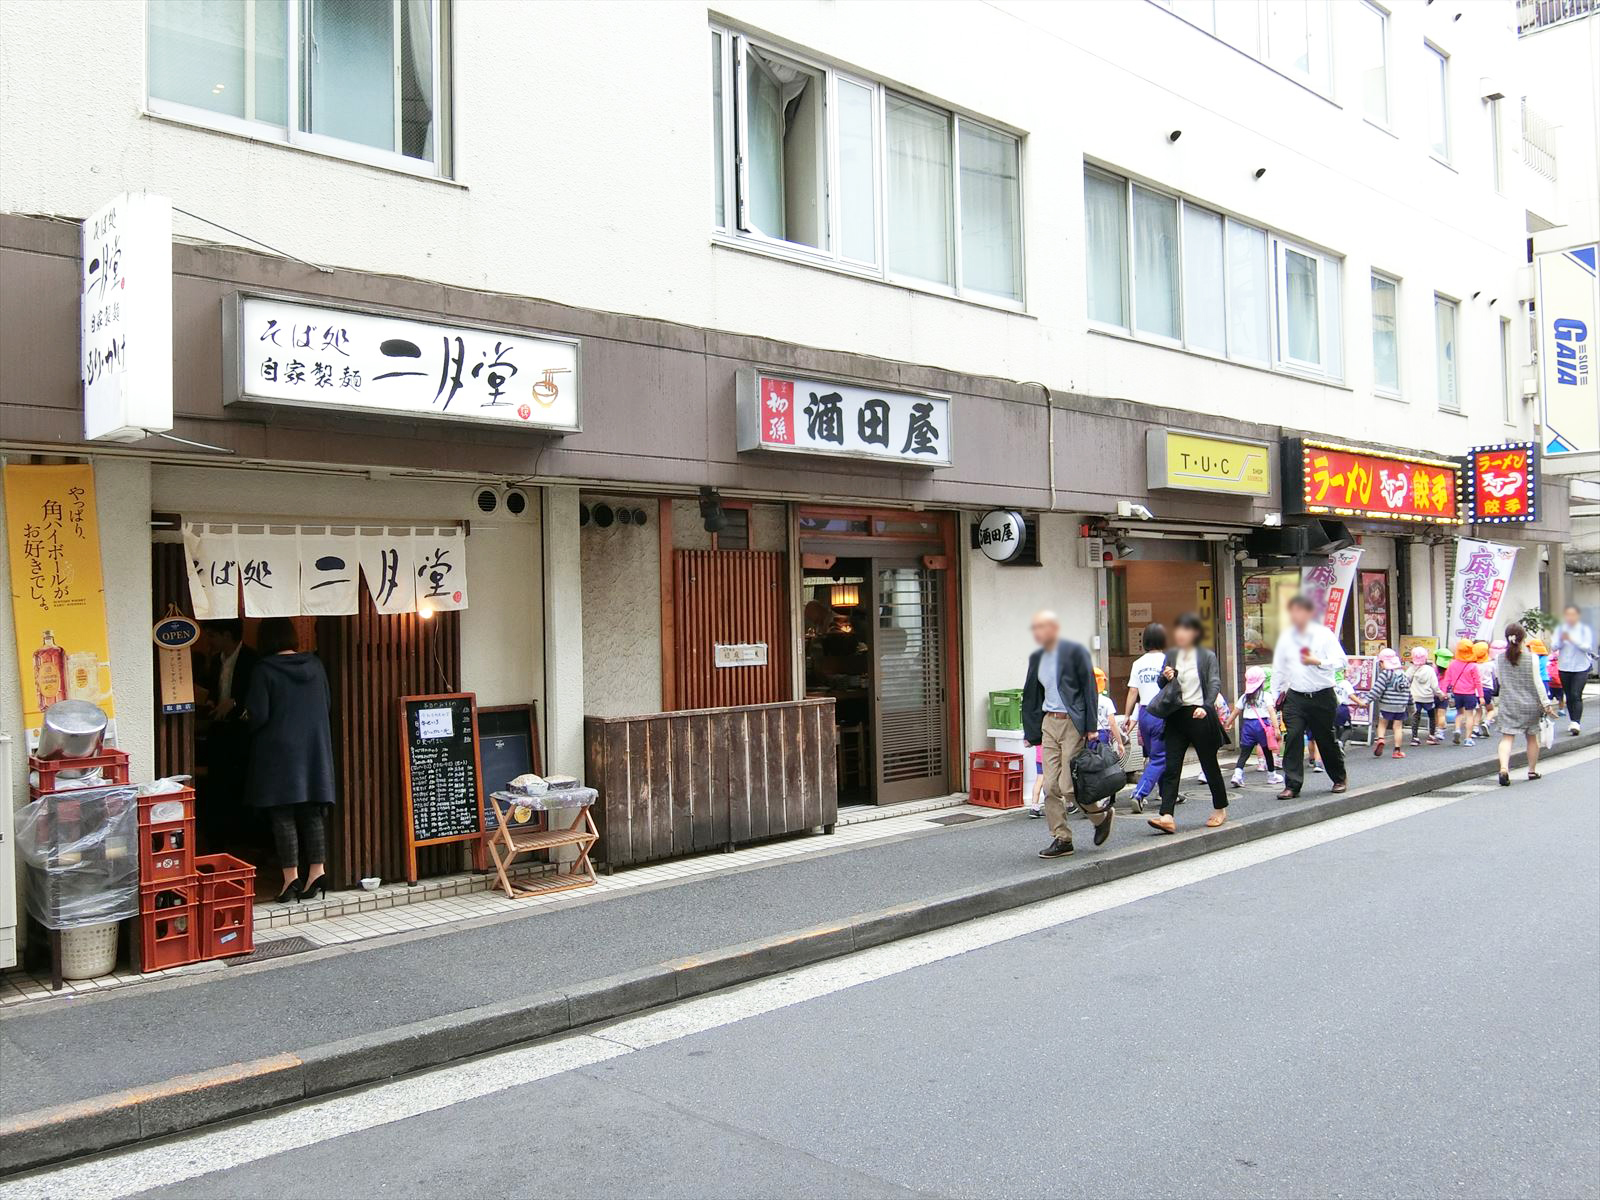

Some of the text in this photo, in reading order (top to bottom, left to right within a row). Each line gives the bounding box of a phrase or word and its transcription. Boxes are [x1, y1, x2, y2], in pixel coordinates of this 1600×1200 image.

[93, 207, 117, 241] そば処
[87, 235, 122, 302] 二月堂
[259, 319, 351, 357] そば処
[1553, 317, 1588, 386] GAIA
[260, 356, 363, 393] 自家製麺
[372, 336, 518, 411] 二月堂
[1579, 354, 1588, 375] SLOT
[766, 391, 789, 442] 初孫
[803, 391, 940, 456] 酒田屋
[1313, 455, 1374, 504] ラーメン
[1412, 470, 1448, 512] 餃子
[1478, 453, 1526, 472] ラーメン
[68, 487, 86, 539] やっぱり、
[1484, 498, 1521, 515] 餃子
[42, 499, 69, 599] 角ハイボールが
[979, 522, 1015, 546] 酒田屋
[24, 523, 49, 611] お好きでしょ。
[310, 548, 452, 606] 二月堂
[162, 630, 191, 641] OPEN
